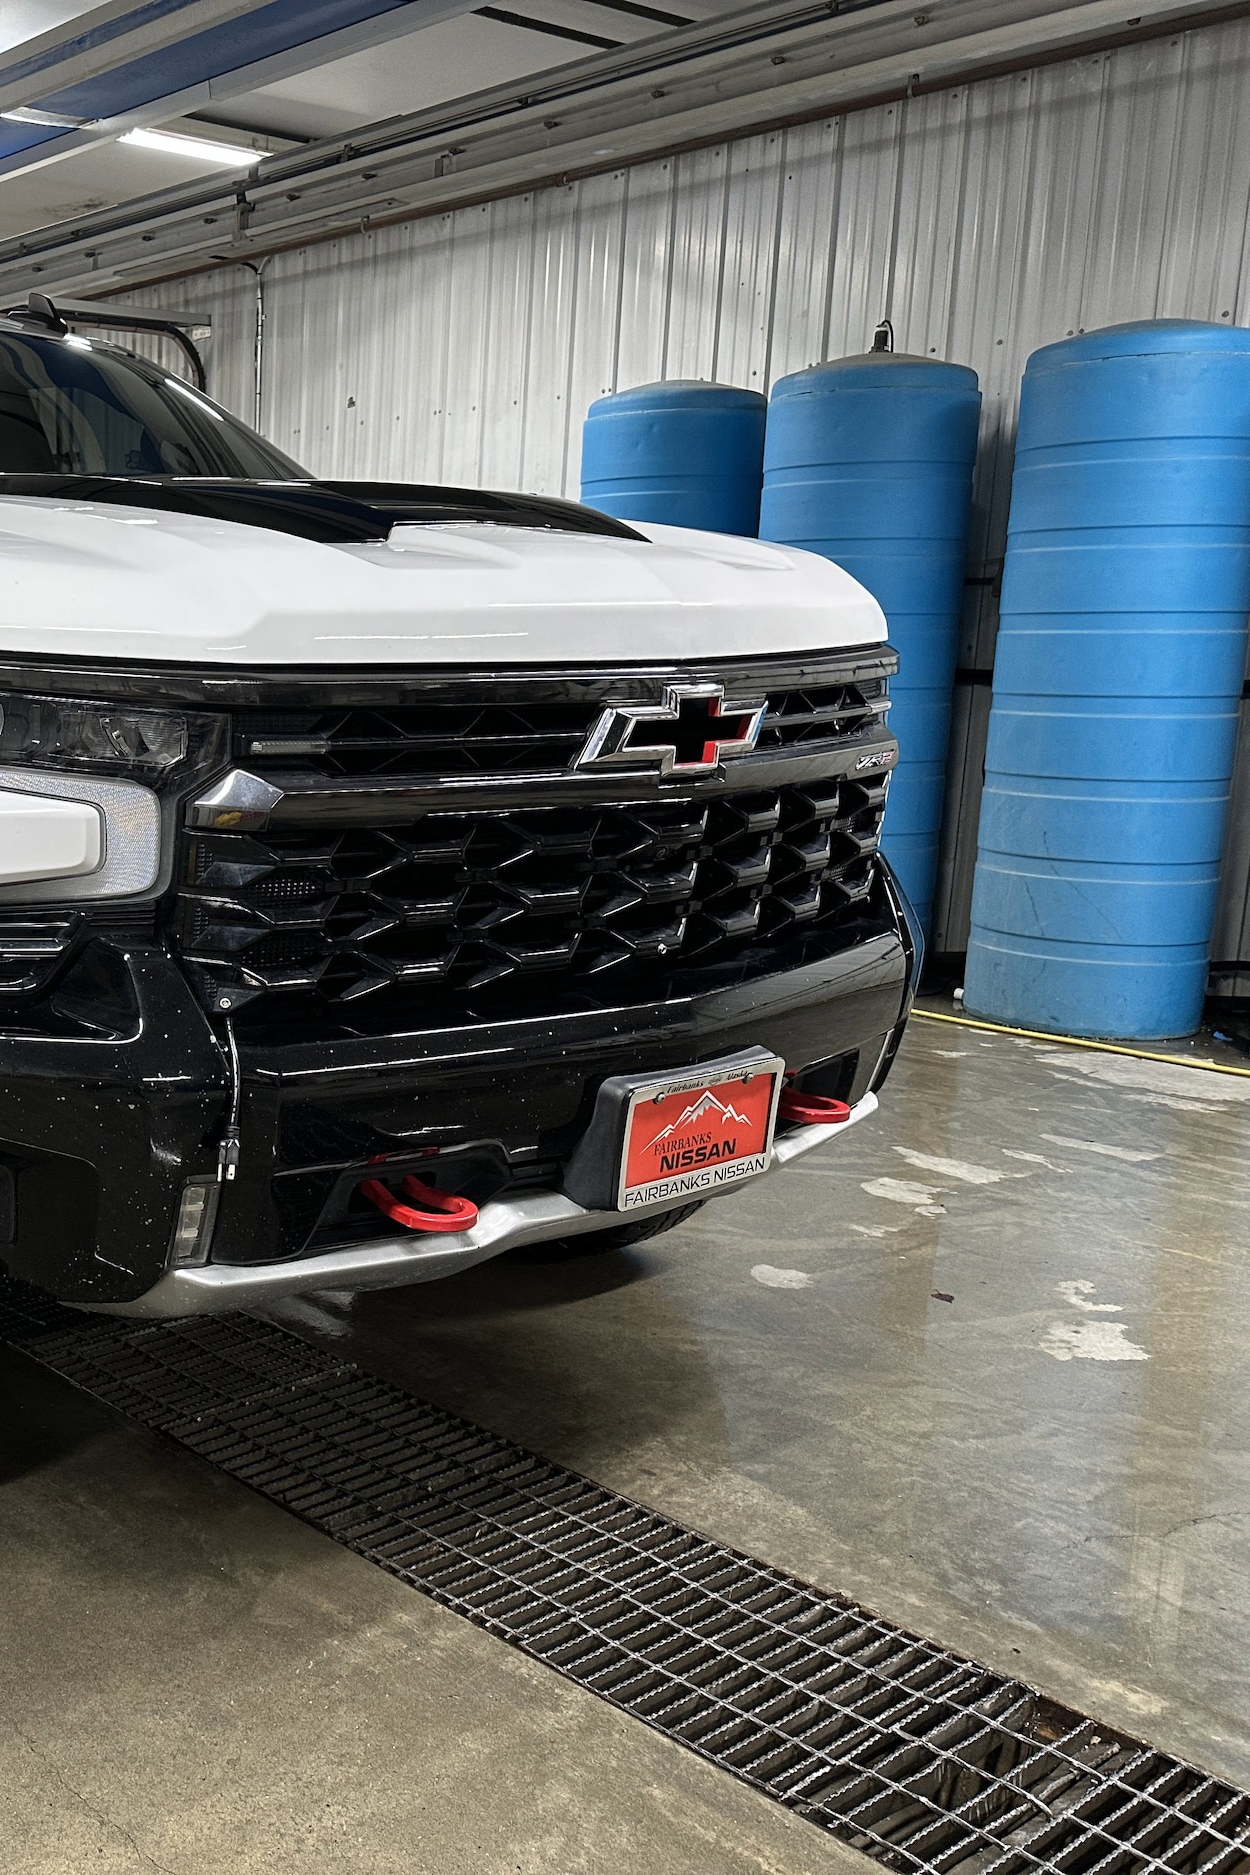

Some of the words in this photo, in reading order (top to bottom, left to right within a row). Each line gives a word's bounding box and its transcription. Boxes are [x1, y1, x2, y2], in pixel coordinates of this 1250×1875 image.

[855, 749, 895, 770] ZR2
[666, 1080, 704, 1094] Fairbanks
[653, 1131, 712, 1156] FAIRBANKS
[659, 1138, 736, 1172] NISSAN
[624, 1172, 710, 1208] FAIRBANKS
[713, 1157, 766, 1183] NISSAN
